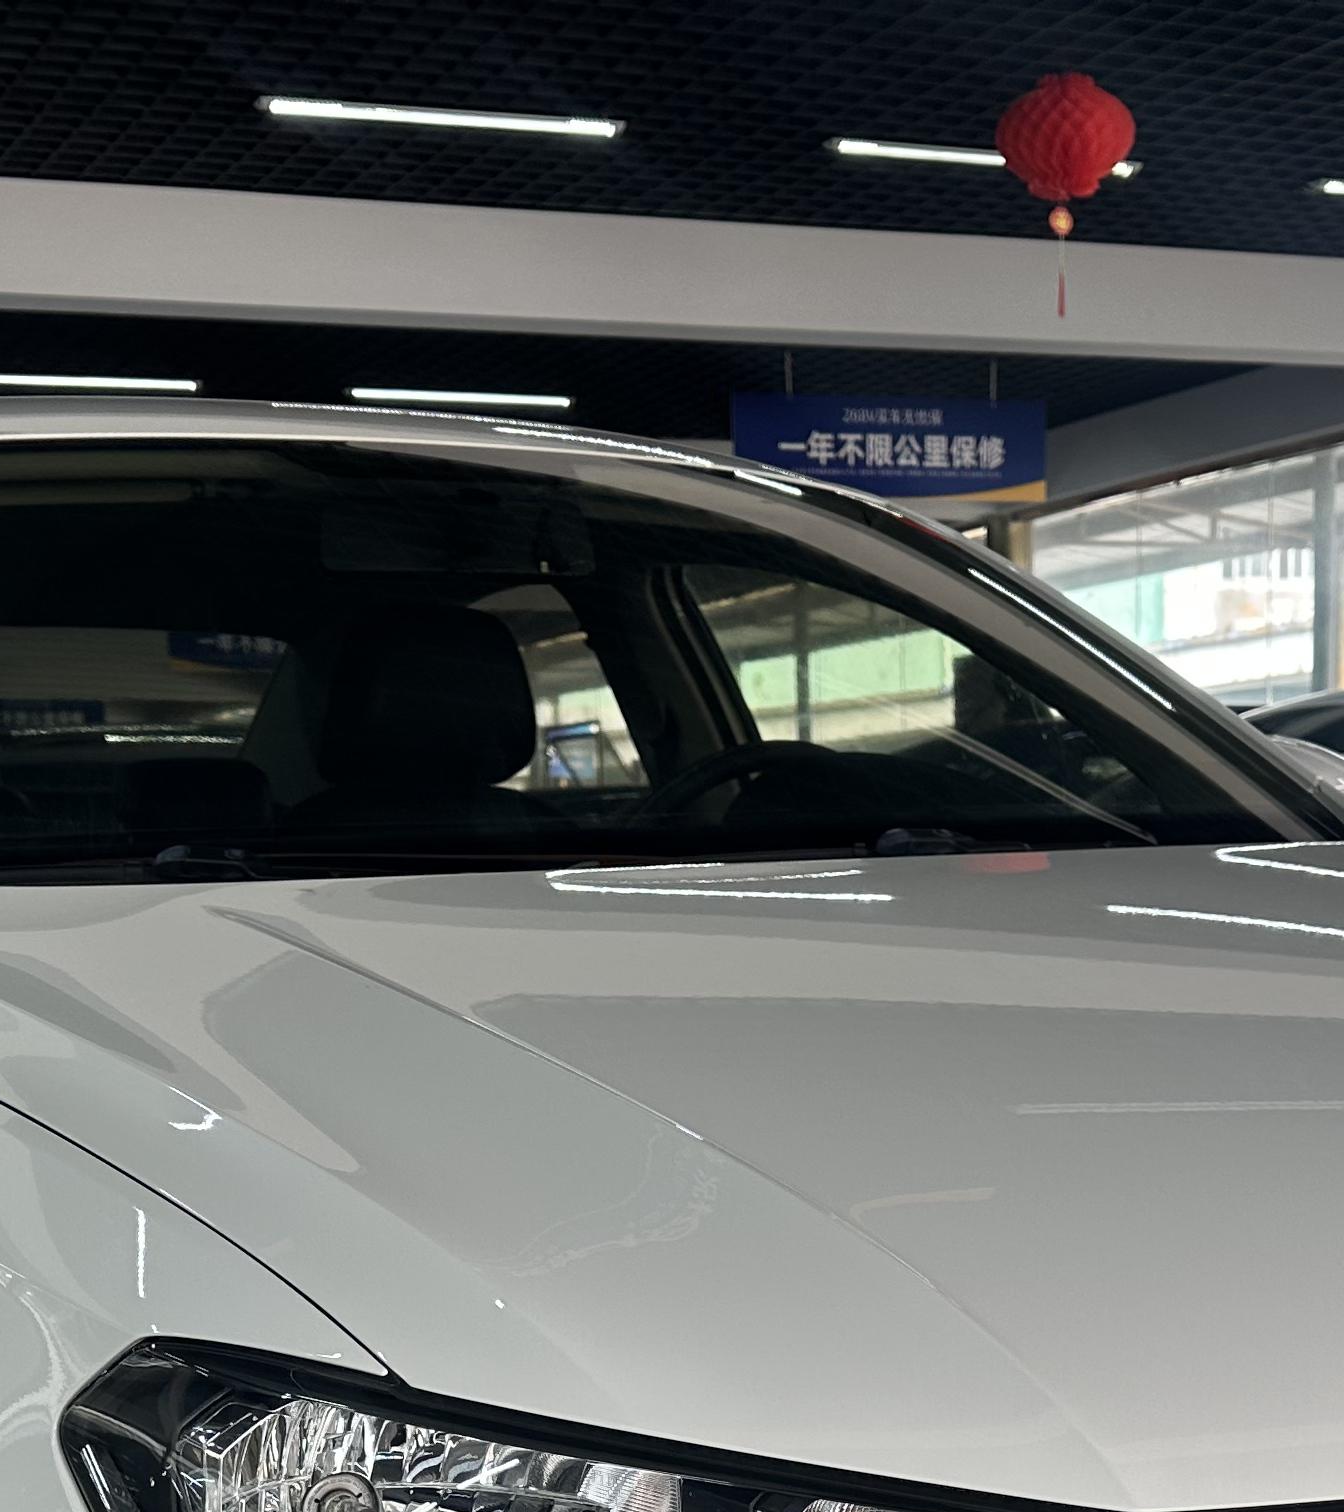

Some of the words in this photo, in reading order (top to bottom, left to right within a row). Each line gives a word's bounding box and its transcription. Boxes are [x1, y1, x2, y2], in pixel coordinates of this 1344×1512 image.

[778, 430, 1006, 470] 一年不限公里保修
